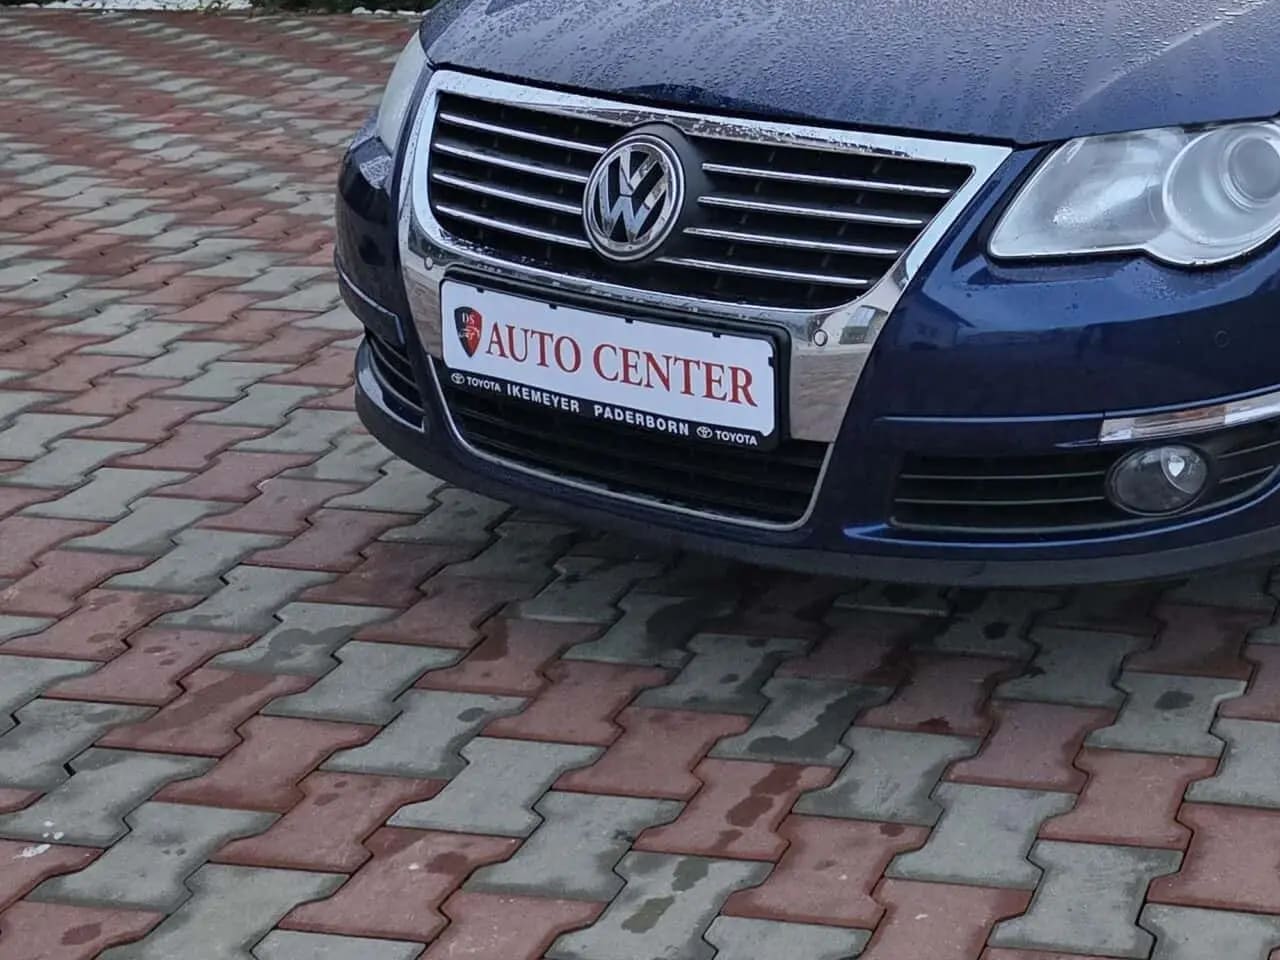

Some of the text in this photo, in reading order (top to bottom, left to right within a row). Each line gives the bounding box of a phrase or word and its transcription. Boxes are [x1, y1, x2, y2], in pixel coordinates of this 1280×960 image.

[486, 321, 759, 408] AUTO CENTER
[466, 375, 759, 447] TOYOTA IKEMEYER PADERBORN TOYOTA
